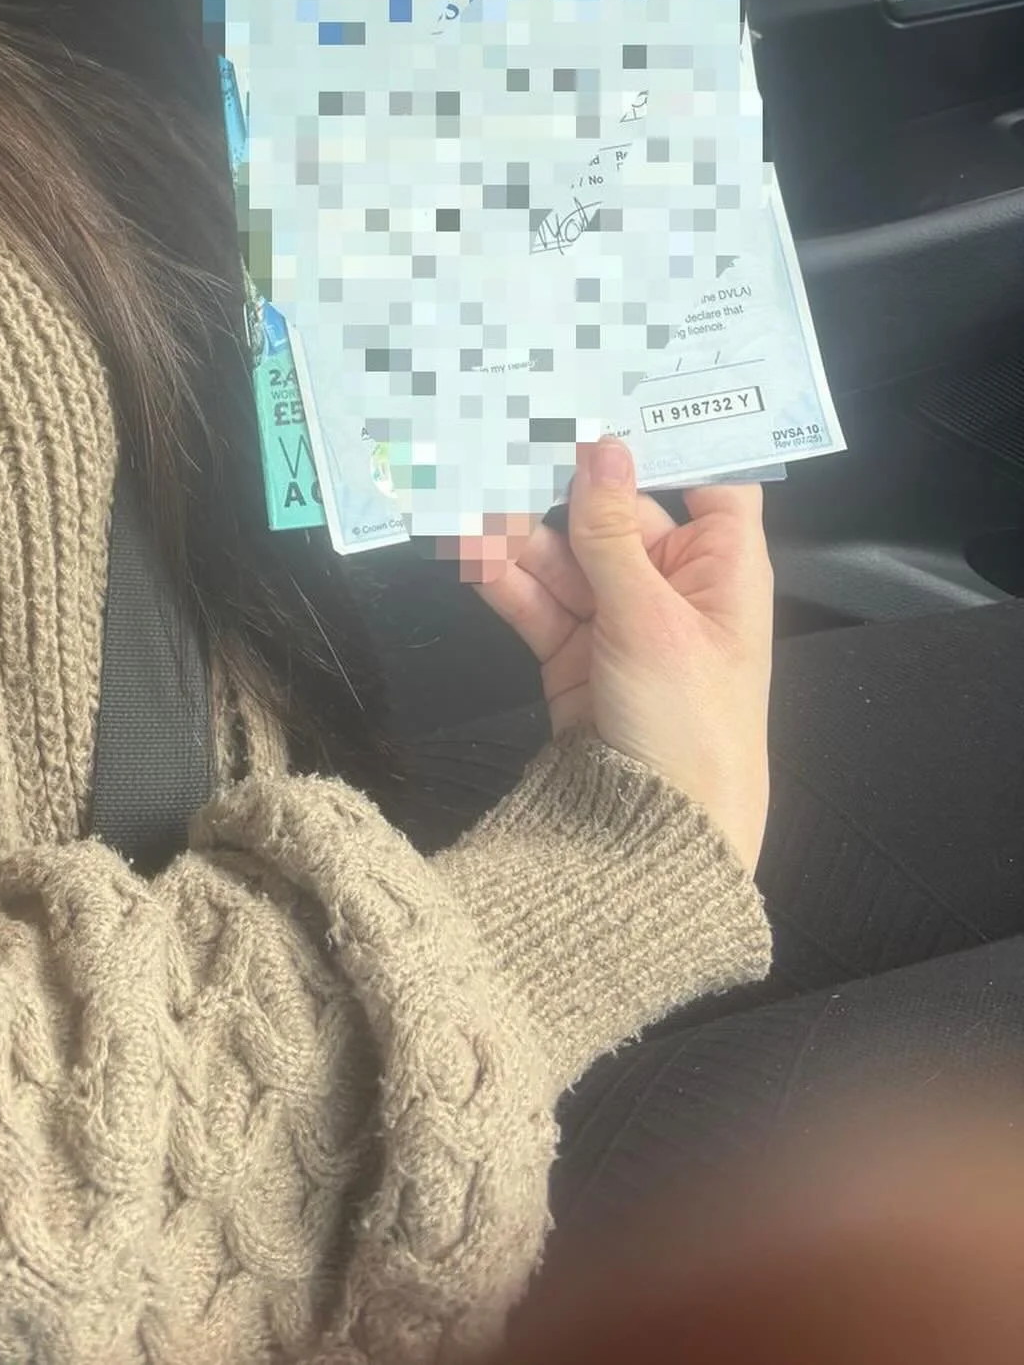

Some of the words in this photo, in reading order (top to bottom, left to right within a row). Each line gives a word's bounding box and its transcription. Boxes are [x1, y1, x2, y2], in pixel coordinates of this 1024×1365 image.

[589, 176, 603, 185] No
[718, 286, 752, 300] DVLA)
[723, 305, 744, 316] that
[652, 410, 665, 424] H
[671, 397, 733, 421] 918732
[738, 393, 749, 408] Y
[772, 427, 805, 441] DVSA
[806, 424, 820, 435] 10
